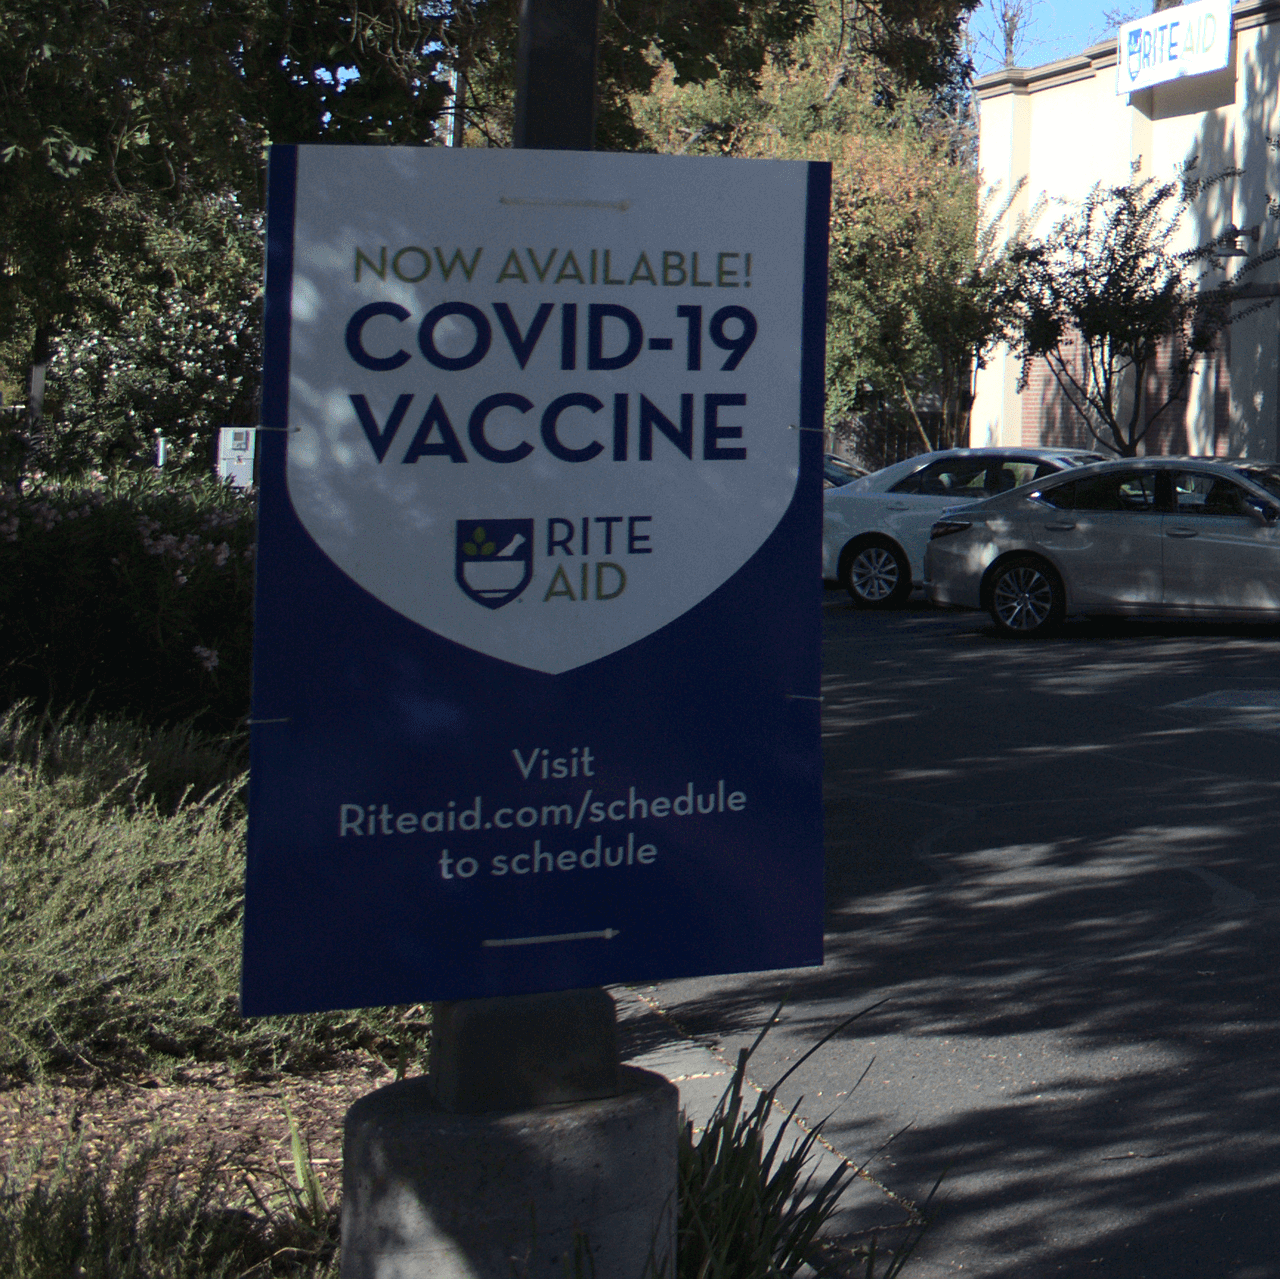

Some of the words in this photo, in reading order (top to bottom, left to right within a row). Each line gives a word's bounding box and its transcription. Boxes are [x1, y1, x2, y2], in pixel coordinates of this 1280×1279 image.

[1142, 20, 1181, 69] RITE
[1182, 12, 1217, 55] AID
[353, 246, 484, 283] NOW
[496, 247, 753, 288] AVAILABLE!
[344, 301, 758, 372] COVID-19
[348, 392, 748, 464] VACCINE
[546, 515, 653, 557] RITE
[542, 562, 627, 602] AID
[512, 746, 595, 780] Visit
[338, 779, 748, 837] Riteaid.com/schedule
[438, 849, 480, 880] to
[490, 832, 659, 876] schedule
